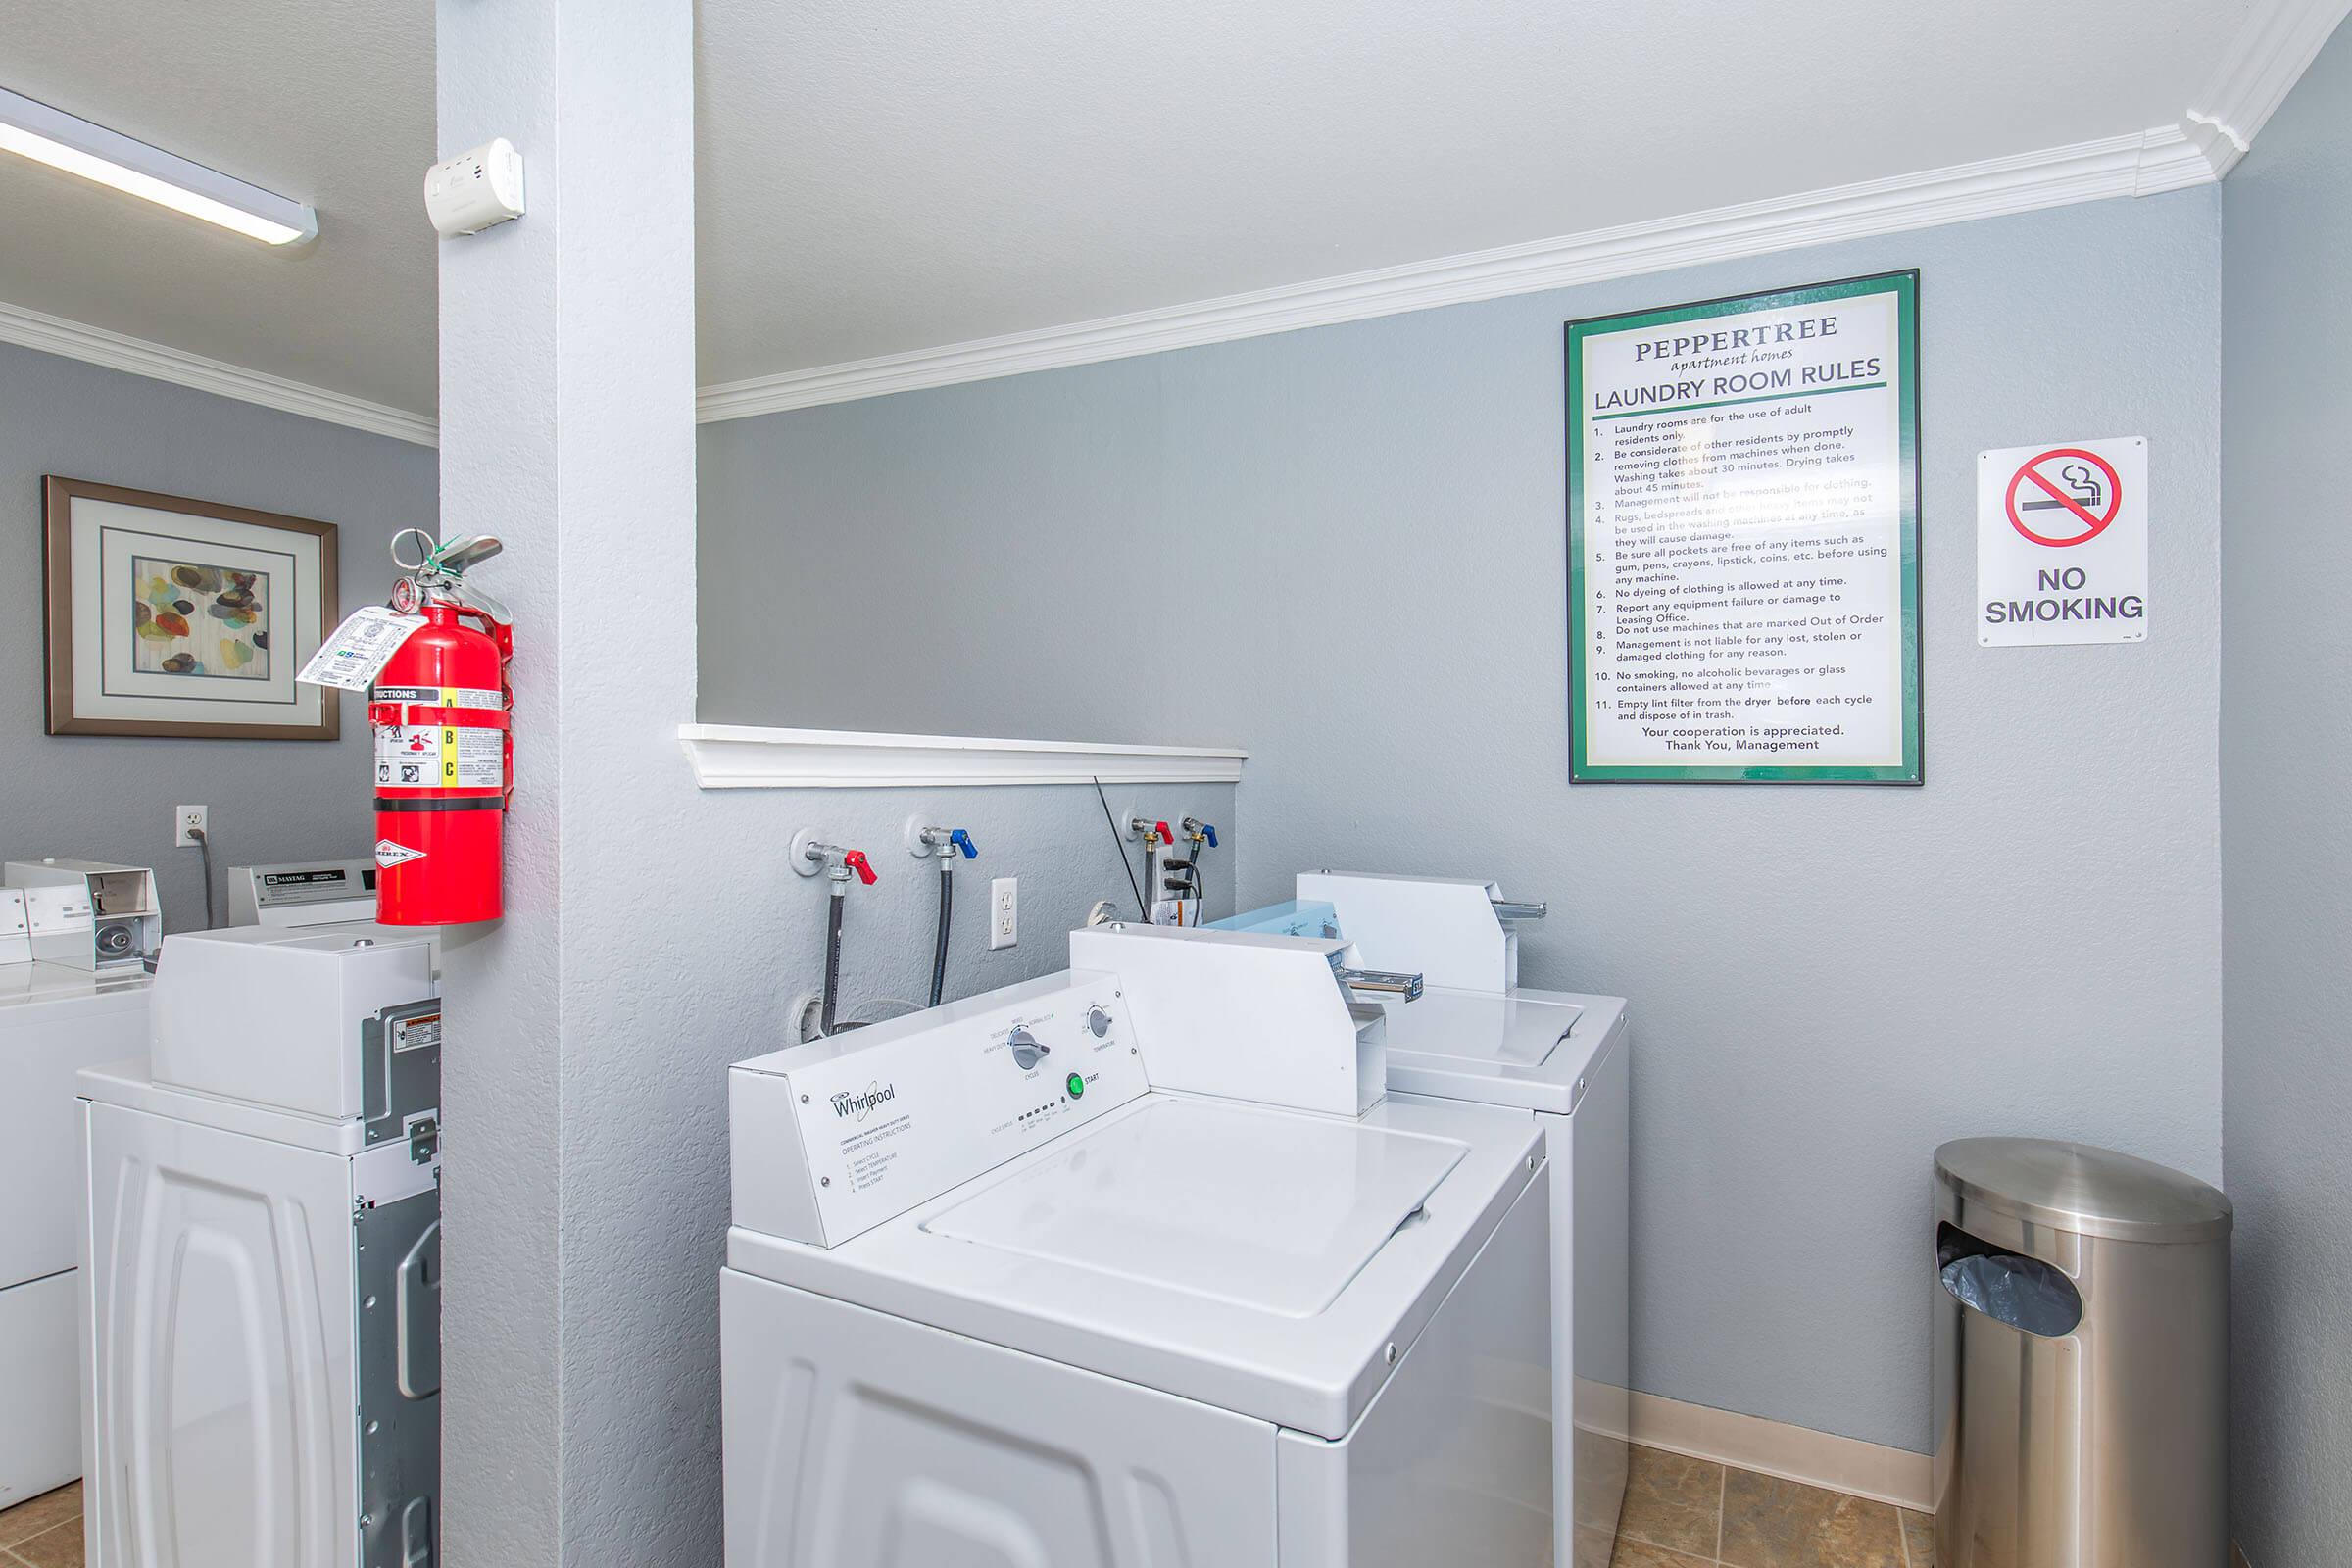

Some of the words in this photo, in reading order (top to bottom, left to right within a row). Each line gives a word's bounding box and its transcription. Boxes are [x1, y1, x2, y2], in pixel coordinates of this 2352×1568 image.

[1635, 316, 1837, 362] PEPPERTREE
[1670, 352, 1747, 378] apartment
[1750, 348, 1792, 363] homes
[1594, 378, 1705, 410] LAUNDRY
[1713, 368, 1791, 396] ROOM
[1801, 357, 1880, 384] RULES
[1593, 427, 1603, 437] 1.
[1614, 421, 1654, 434] Laundry
[1656, 419, 1688, 429] rooms
[1709, 413, 1725, 423] for
[1728, 411, 1745, 421] the
[1748, 410, 1766, 419] use
[1769, 405, 1782, 416] of
[1784, 403, 1811, 416] adult
[1594, 451, 1604, 461] 2.
[1613, 450, 1627, 459] Be
[1629, 445, 1687, 458] considerate
[1703, 438, 1733, 449] other
[1735, 434, 1784, 447] residents
[1786, 431, 1800, 443] by
[1802, 425, 1853, 442] promptly
[1614, 434, 1660, 446] residents
[1595, 552, 1605, 562] 5.
[1614, 550, 1628, 560] Be
[1653, 547, 1666, 558] all
[1668, 545, 1708, 559] pockets
[1710, 545, 1728, 554] are
[1730, 541, 1751, 552] free
[1754, 540, 1766, 551] of
[1768, 541, 1788, 551] any
[1790, 538, 1821, 548] items
[1823, 534, 1848, 546] such
[1851, 535, 1864, 544] as
[1614, 564, 1640, 574] gum,
[1642, 562, 1669, 573] pens,
[1672, 559, 1714, 570] crayons,
[1717, 554, 1756, 567] lipstick,
[1759, 552, 1789, 563] coins,
[1792, 552, 1814, 561] etc.
[1817, 548, 1854, 559] before
[1857, 546, 1887, 558] using
[1595, 589, 1606, 599] 6.
[1615, 588, 1630, 598] No
[1632, 586, 1666, 599] dyeing
[1669, 584, 1680, 595] of
[1682, 583, 1724, 595] clothing
[1726, 582, 1735, 591] is
[1738, 579, 1780, 591] allowed
[1782, 579, 1793, 588] at
[1795, 579, 1816, 590] any
[1818, 576, 1846, 587] time.
[1614, 576, 1633, 586] any
[1635, 572, 1679, 583] machine.
[2038, 567, 2086, 591] NO
[1595, 604, 1606, 613] 7.
[1616, 603, 1649, 614] Report
[1651, 603, 1670, 612] any
[1672, 599, 1728, 612] equipment
[1730, 596, 1764, 607] failure
[1782, 594, 1826, 605] damage
[1829, 593, 1841, 602] to
[1985, 595, 2143, 624] SMOKING
[1595, 630, 1606, 640] 8.
[1615, 625, 1631, 635] Do
[1633, 623, 1651, 634] not
[1672, 621, 1719, 632] machines
[1722, 619, 1743, 630] that
[1766, 616, 1806, 628] marked
[1809, 615, 1832, 626] Out
[1834, 613, 1846, 625] of
[1849, 613, 1884, 624] Order
[1616, 614, 1653, 625] Leasing
[1655, 612, 1690, 623] Office.
[1595, 645, 1605, 655] 9.
[1616, 639, 1681, 651] Management
[1683, 637, 1691, 647] is
[1693, 637, 1711, 646] not
[1714, 635, 1742, 646] liable
[1744, 634, 1761, 644] for
[1764, 636, 1784, 646] any
[1786, 632, 1809, 643] lost,
[1812, 631, 1846, 642] stolen
[1615, 651, 1662, 662] damaged
[1664, 650, 1705, 662] clothing
[1708, 648, 1724, 659] for
[1726, 650, 1745, 660] any
[1594, 671, 1611, 681] 10.
[1616, 670, 1631, 680] No
[1633, 669, 1678, 681] smoking,
[1696, 666, 1742, 678] alcoholic
[1818, 663, 1846, 677] glass
[1616, 682, 1667, 693] containers
[1669, 680, 1709, 691] allowed
[1712, 681, 1723, 690] at
[1725, 682, 1744, 691] any
[1595, 699, 1611, 710] 11.
[1617, 699, 1649, 710] Empty
[1651, 698, 1668, 708] lint
[1670, 697, 1693, 707] filter
[1696, 697, 1721, 707] from
[1724, 697, 1741, 707] the
[1744, 696, 1771, 708] dryer
[1777, 695, 1811, 706] before
[1815, 694, 1840, 705] each
[1843, 693, 1872, 706] cycle
[1617, 710, 1636, 720] and
[1638, 710, 1677, 722] dispose
[1679, 710, 1690, 719] of
[1692, 710, 1702, 719] in
[1704, 709, 1734, 719] trash.
[446, 731, 454, 744] B
[1642, 726, 1669, 737] Your
[1672, 725, 1745, 739] cooperation
[1749, 725, 1759, 736] is
[1763, 723, 1844, 739] appreciated.
[1664, 739, 1701, 751] Thank
[1704, 739, 1731, 752] You,
[1735, 739, 1819, 752] Management
[446, 762, 454, 776] C
[278, 874, 305, 883] MAYTAG
[1085, 1073, 1099, 1085] START
[833, 1083, 895, 1118] Whirlpool
[842, 1137, 874, 1155] OPERATING
[874, 1122, 911, 1143] INSTRUCTIONS
